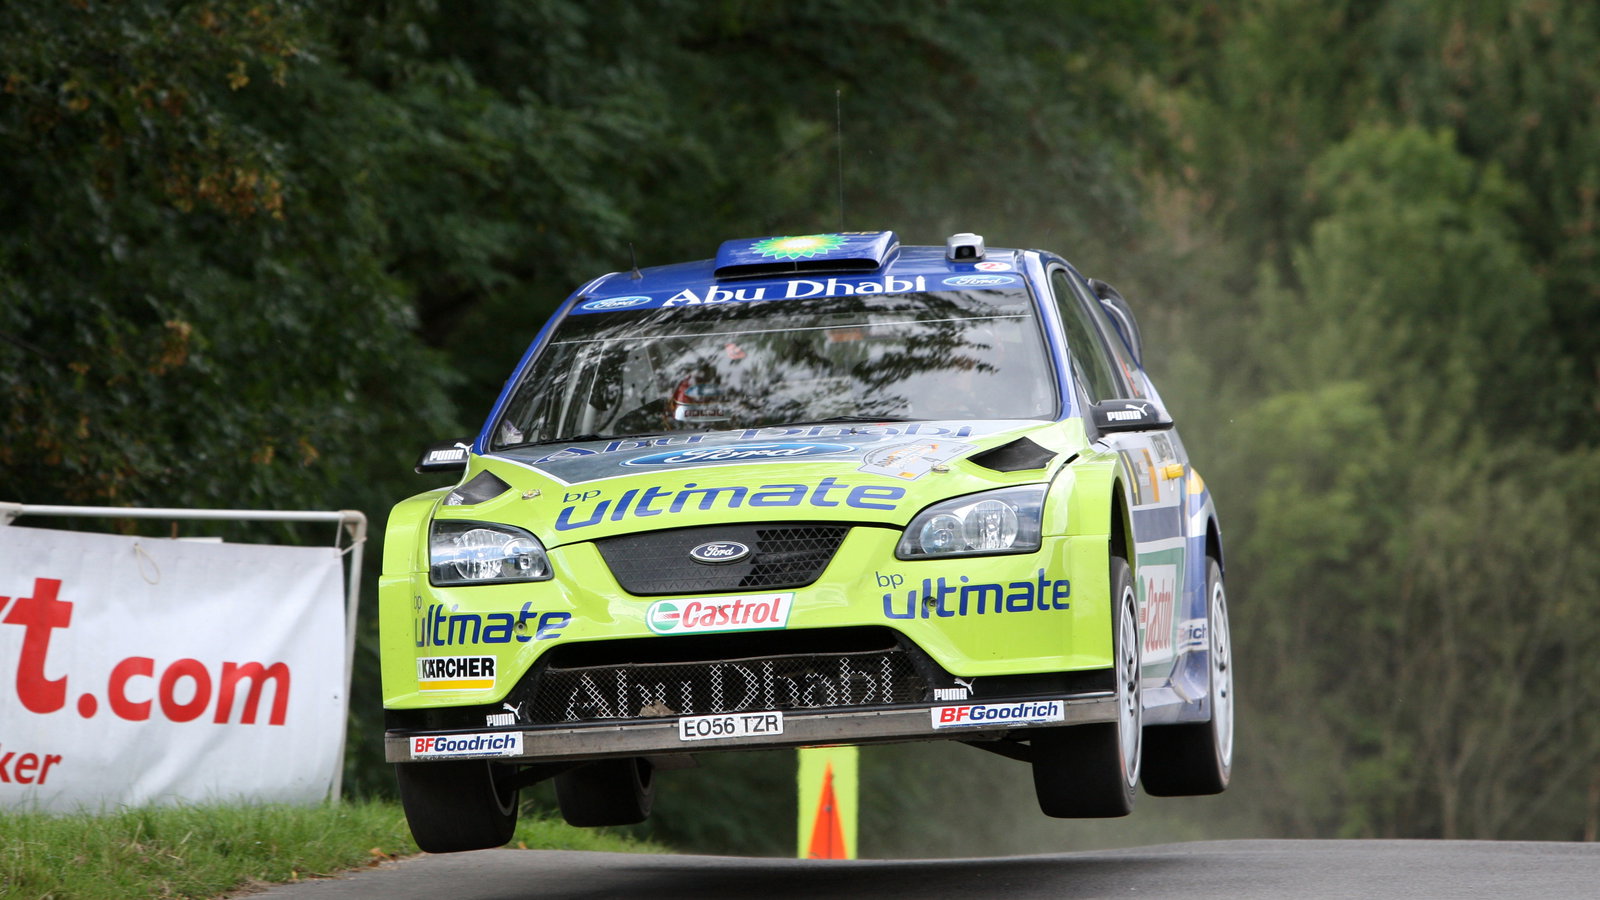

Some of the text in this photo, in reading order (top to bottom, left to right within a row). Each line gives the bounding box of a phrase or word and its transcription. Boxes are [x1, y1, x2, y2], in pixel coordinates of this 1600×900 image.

[662, 275, 926, 307] Abu Dhabi
[1106, 410, 1142, 421] PUMA
[429, 448, 463, 462] PUMA
[532, 435, 705, 464] Abu
[663, 444, 816, 463] Ford
[554, 476, 906, 531] ultimate
[563, 489, 601, 503] bp
[703, 543, 735, 558] Ford
[875, 570, 904, 589] bp
[883, 567, 1070, 619] ultimate
[682, 597, 781, 628] Castrol
[1145, 577, 1174, 653] Castrol
[414, 601, 572, 647] ultimate
[565, 656, 893, 721] Abu Dhabi
[933, 687, 968, 701] PUMA
[486, 713, 516, 727] PUMA
[940, 700, 1059, 722] BFGoodrich
[684, 715, 779, 738] EO56 TZR
[414, 734, 516, 753] BFGoodrich
